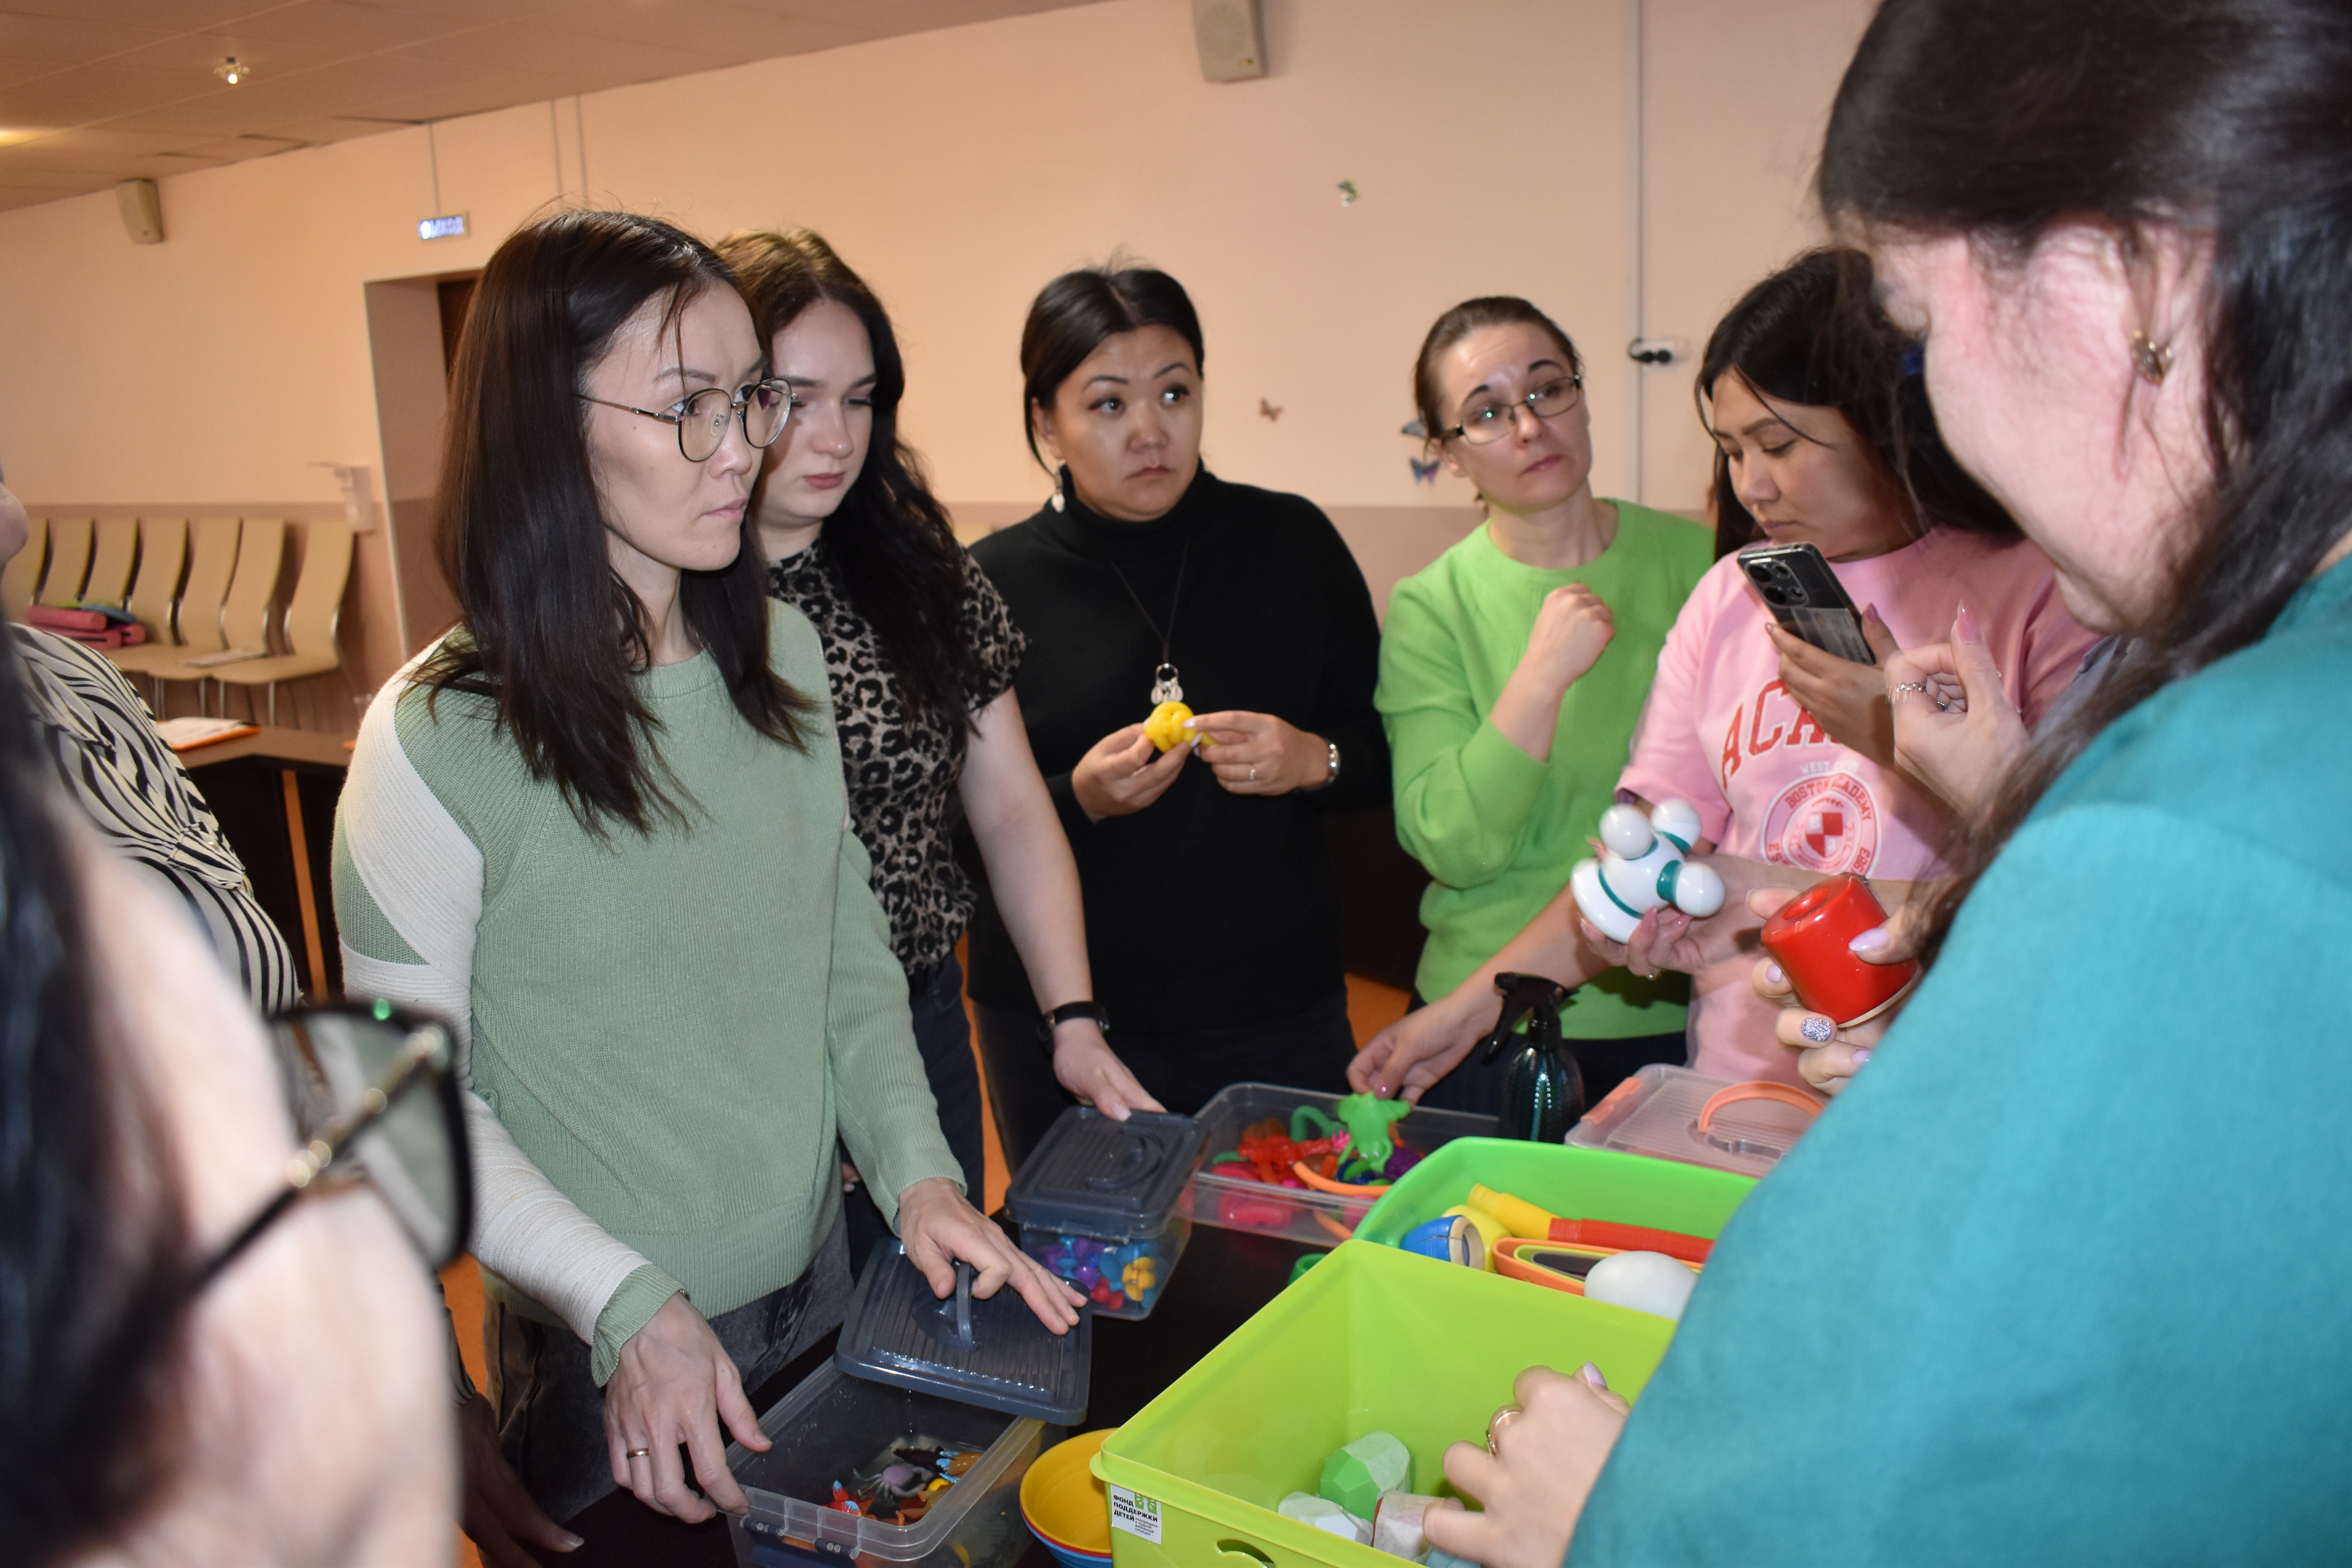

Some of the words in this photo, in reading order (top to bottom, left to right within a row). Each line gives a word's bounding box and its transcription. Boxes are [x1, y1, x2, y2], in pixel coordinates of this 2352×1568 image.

[1721, 678, 1842, 792] ACA
[1800, 760, 1830, 774] WEST
[1113, 1495, 1134, 1507] ФОНД
[1114, 1501, 1158, 1522] ПОДДЕРЖКИ
[1114, 1509, 1134, 1521] ДЕТЕЙ
